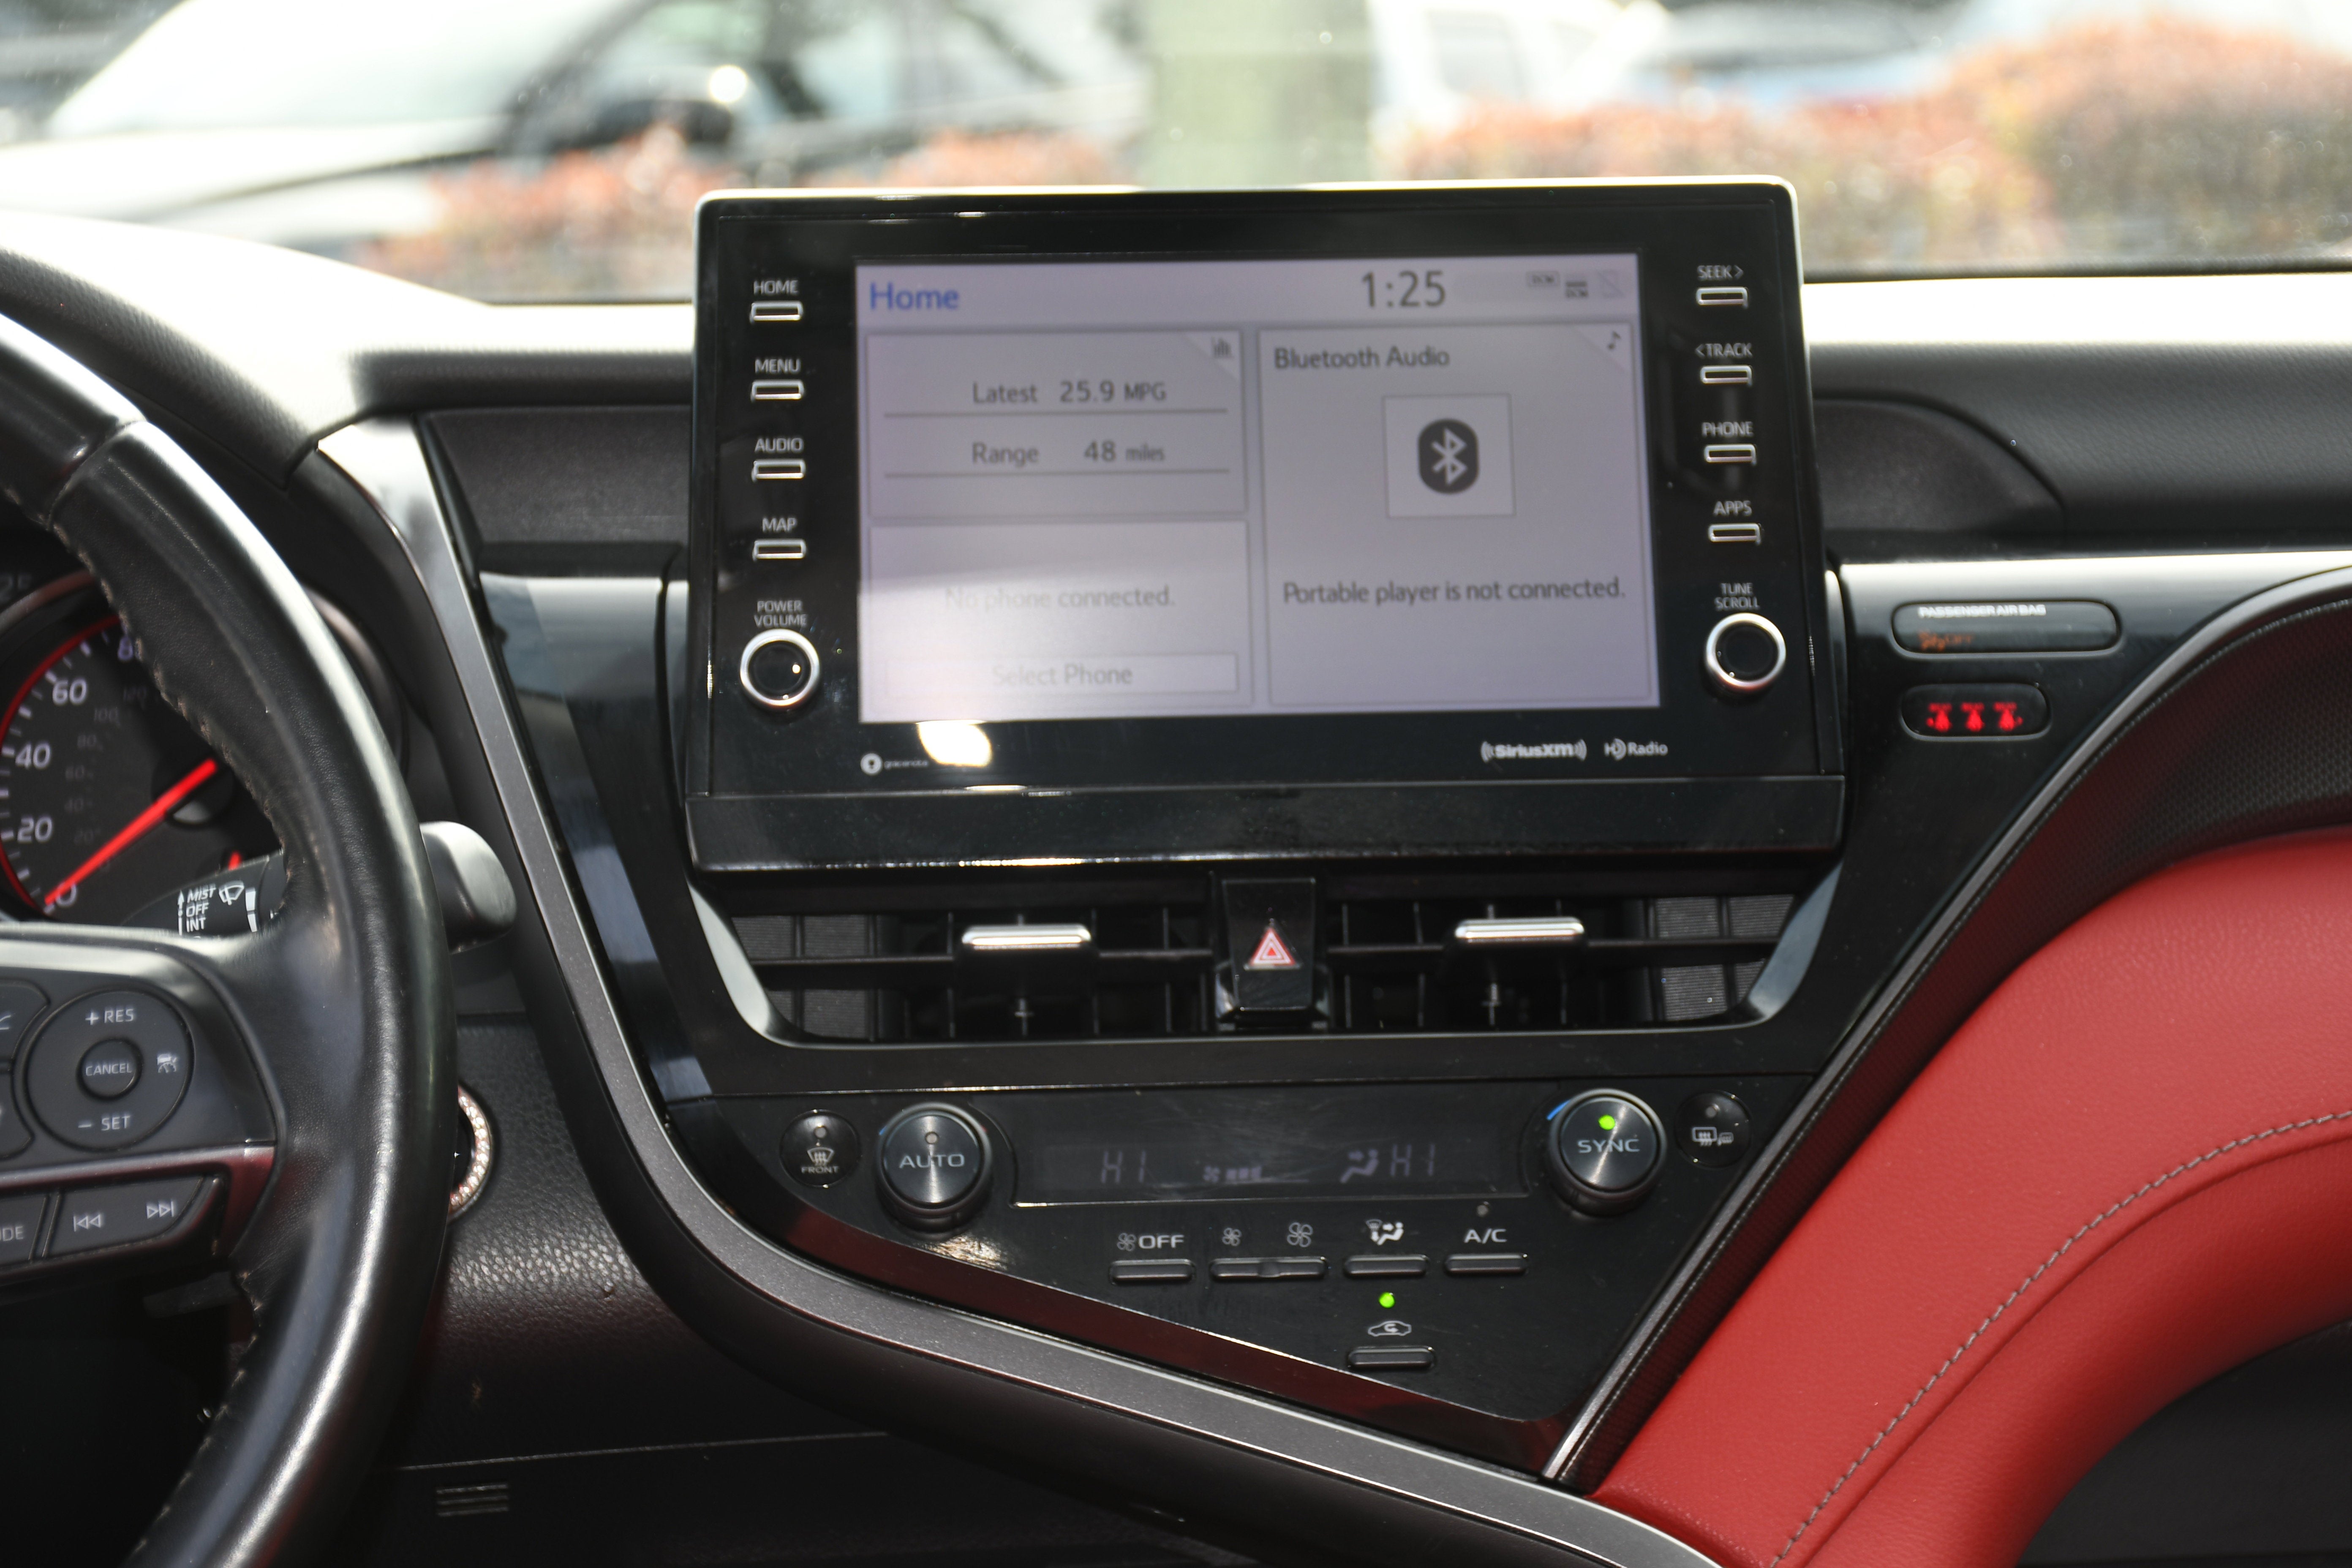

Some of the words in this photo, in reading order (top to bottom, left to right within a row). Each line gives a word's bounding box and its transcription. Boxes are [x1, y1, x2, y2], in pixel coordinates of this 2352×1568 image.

[753, 280, 798, 295] HOME
[1361, 270, 1446, 308] 1:25
[869, 281, 959, 310] Home
[754, 357, 800, 373] MENU
[1274, 347, 1380, 369] Bluetooth
[1386, 346, 1450, 367] Audio
[972, 383, 1038, 403] Latest
[1059, 380, 1115, 403] 25.9
[1124, 382, 1166, 401] MPG
[1701, 422, 1754, 437] PHONE
[754, 437, 803, 452] AUDIO
[972, 442, 1039, 467] Range
[1083, 441, 1116, 462] 48
[1125, 444, 1165, 461] miles
[1713, 501, 1753, 516] APPS
[762, 517, 798, 532] MAP
[1283, 581, 1369, 604] Portable
[1375, 580, 1439, 606] player
[1445, 580, 1462, 600] is
[1466, 580, 1503, 600] not
[1508, 577, 1626, 599] connected.
[1720, 583, 1753, 596] TUNE
[985, 587, 1051, 612] phone
[1057, 584, 1176, 607] connected.
[1714, 596, 1760, 611] SCROLL
[757, 600, 802, 612] POWER
[754, 613, 807, 627] VOLUME
[992, 665, 1057, 686] Select
[1064, 663, 1133, 685] Phone
[52, 680, 87, 705] 60
[15, 743, 51, 769] 40
[1628, 741, 1668, 756] Radio
[18, 817, 52, 842] 20
[188, 885, 216, 903] MIST
[186, 902, 209, 917] OFF
[186, 917, 206, 933] INT
[85, 1063, 132, 1076] CANCEL
[1578, 1139, 1640, 1154] SYNC
[899, 1153, 965, 1169] AUTO
[802, 1165, 839, 1174] FRONT
[0, 1226, 24, 1241] DE
[1464, 1228, 1507, 1243] A/C
[1138, 1234, 1184, 1250] OFF
